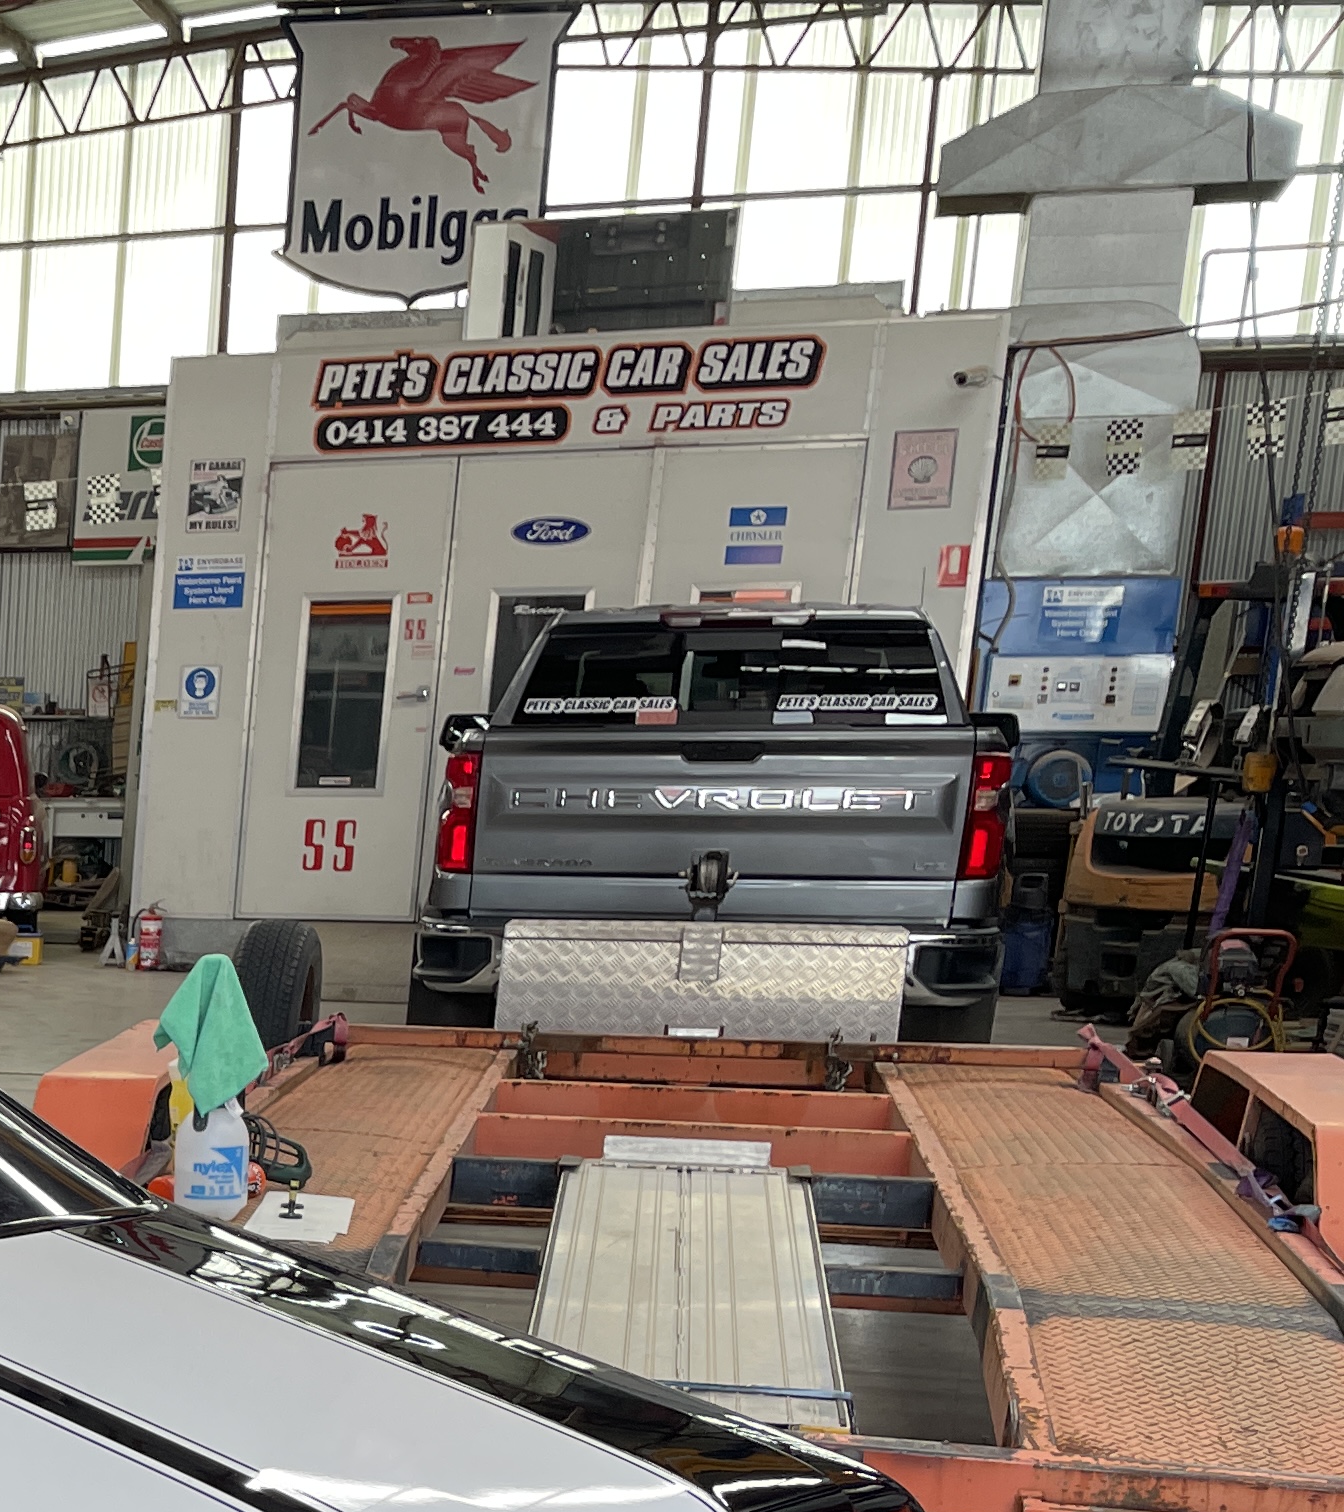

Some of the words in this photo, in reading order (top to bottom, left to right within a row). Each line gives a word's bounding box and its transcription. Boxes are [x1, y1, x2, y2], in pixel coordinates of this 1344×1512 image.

[318, 355, 430, 401] PETE'S
[443, 351, 596, 396] CLASSIC
[606, 347, 684, 388] CAR
[698, 340, 815, 384] SALES
[595, 407, 627, 433] &
[652, 402, 787, 431] PARTS
[325, 418, 408, 446] 0414
[417, 415, 480, 442] 387
[487, 411, 557, 439] 444
[140, 436, 164, 449] Cast
[194, 461, 207, 471] MY
[209, 460, 242, 472] GARAGE
[189, 520, 203, 530] MY
[525, 520, 576, 542] Ford
[730, 530, 782, 541] CHRYSLER
[337, 559, 387, 569] HOLDEN
[525, 700, 561, 711] PETE'S
[563, 699, 611, 711] CLASSIC
[613, 699, 638, 710] CAR
[639, 698, 673, 710] SALES
[779, 696, 817, 708] PETE'S
[819, 696, 869, 708] CLASSIC
[870, 696, 896, 708] CAR
[899, 695, 935, 708] SALES
[510, 788, 936, 811] CHEVROLET
[302, 819, 357, 872] SS
[193, 1160, 234, 1176] nylex
